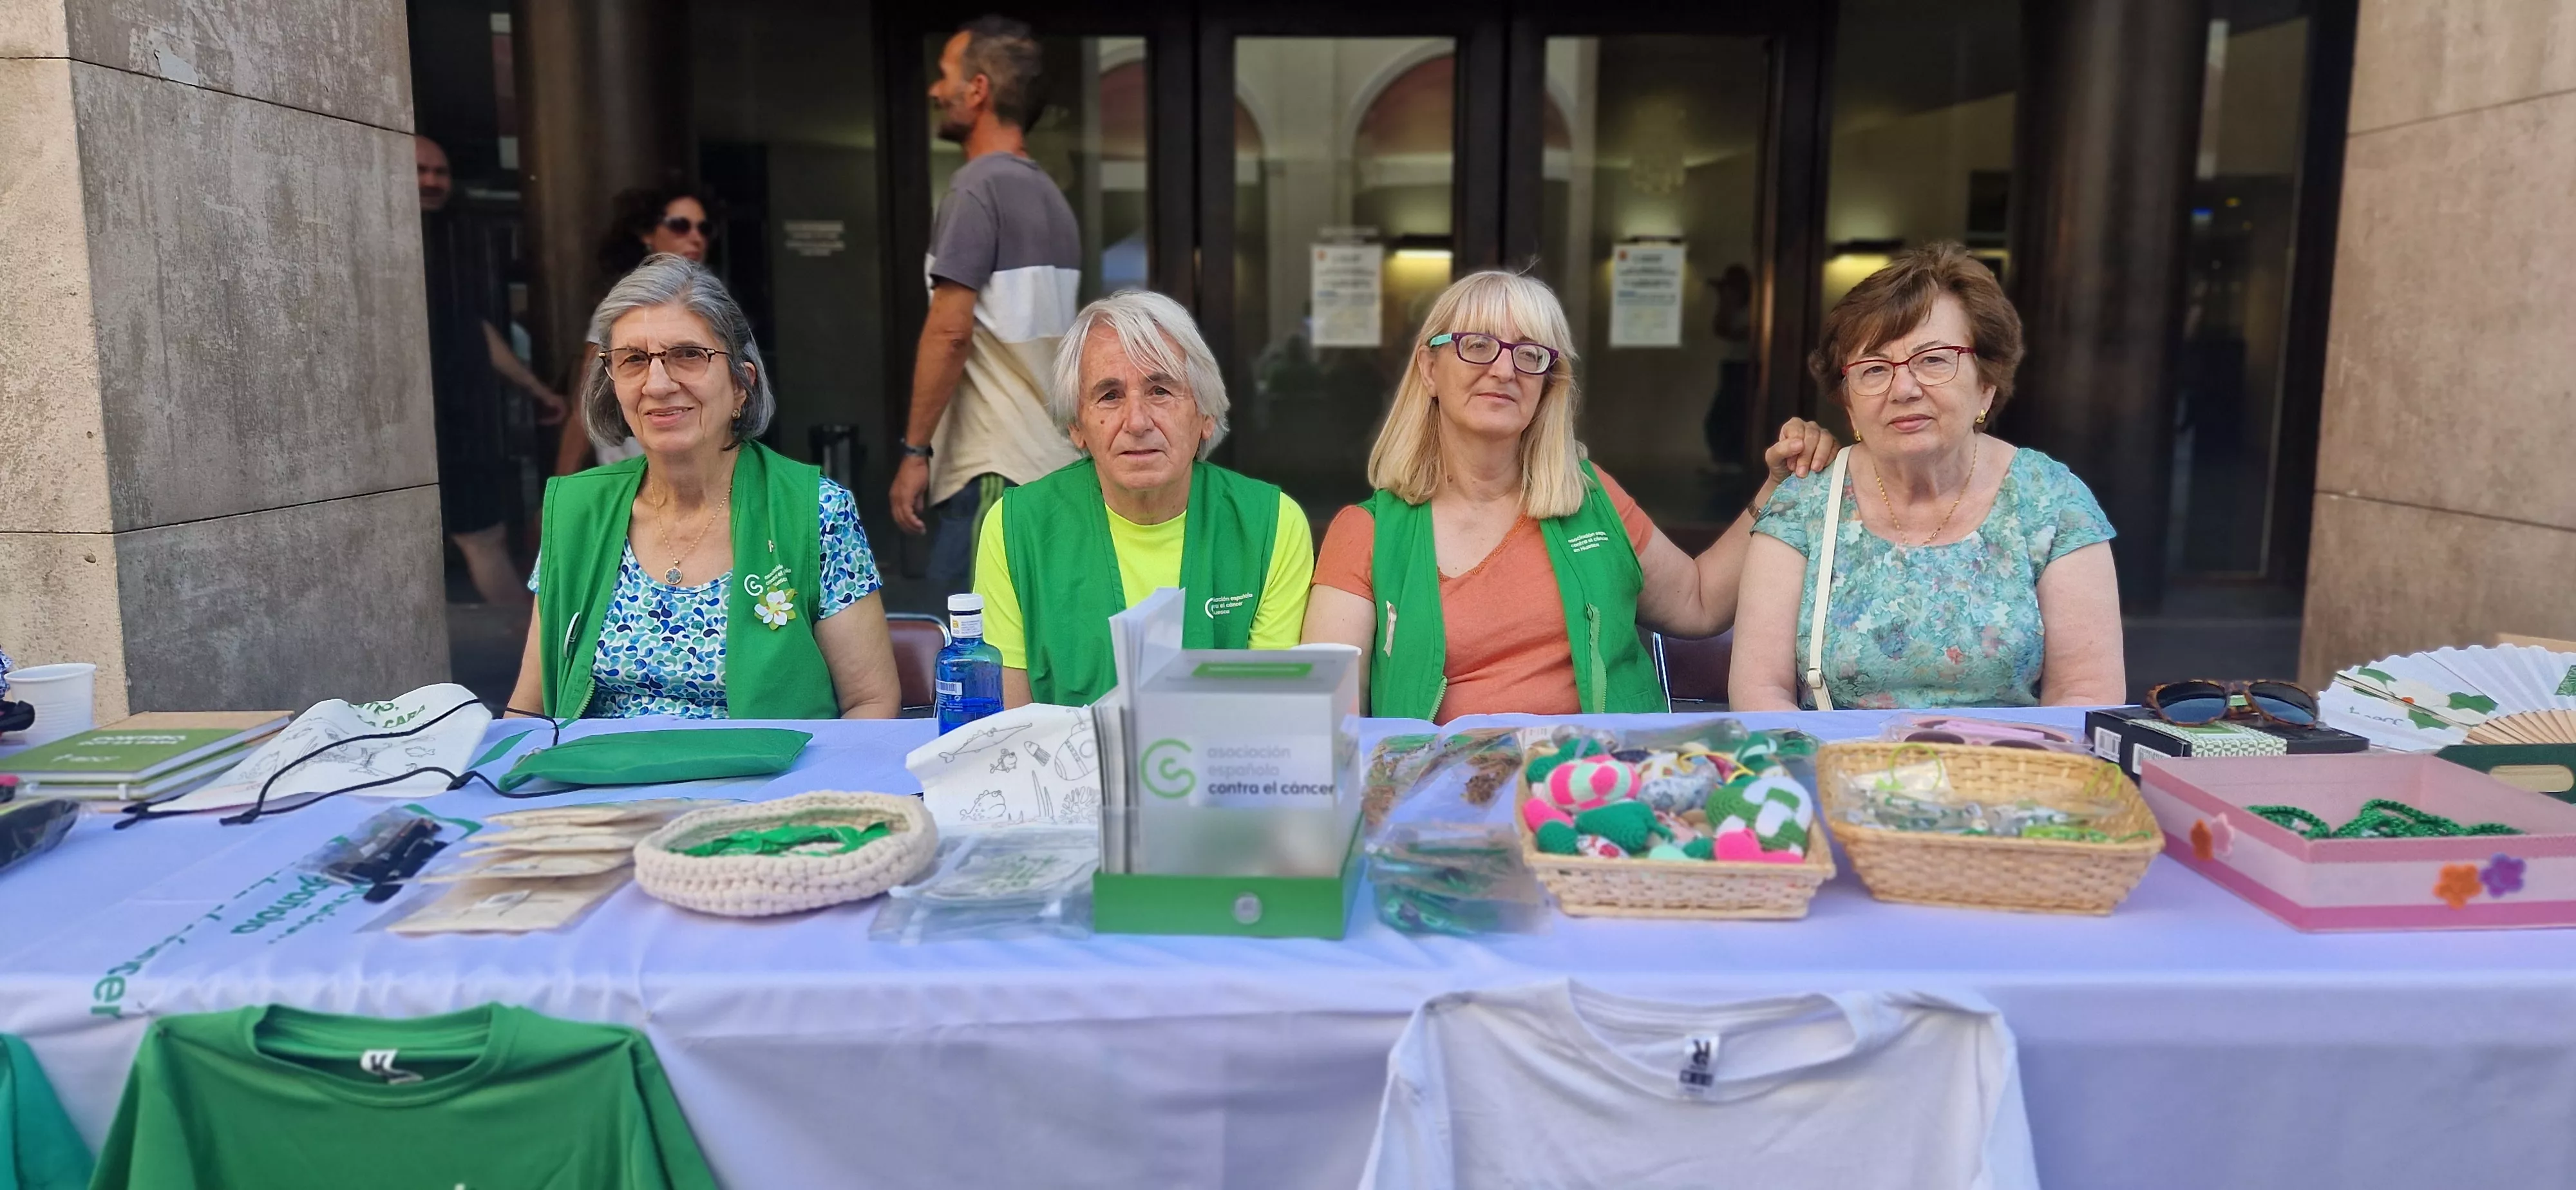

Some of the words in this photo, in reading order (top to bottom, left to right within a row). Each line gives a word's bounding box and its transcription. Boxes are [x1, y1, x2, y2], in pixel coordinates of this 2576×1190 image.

[1207, 744, 1291, 759] asociación
[1207, 762, 1280, 779] española
[1208, 781, 1260, 795] contra
[1263, 780, 1277, 795] el
[1280, 781, 1336, 795] cáncer
